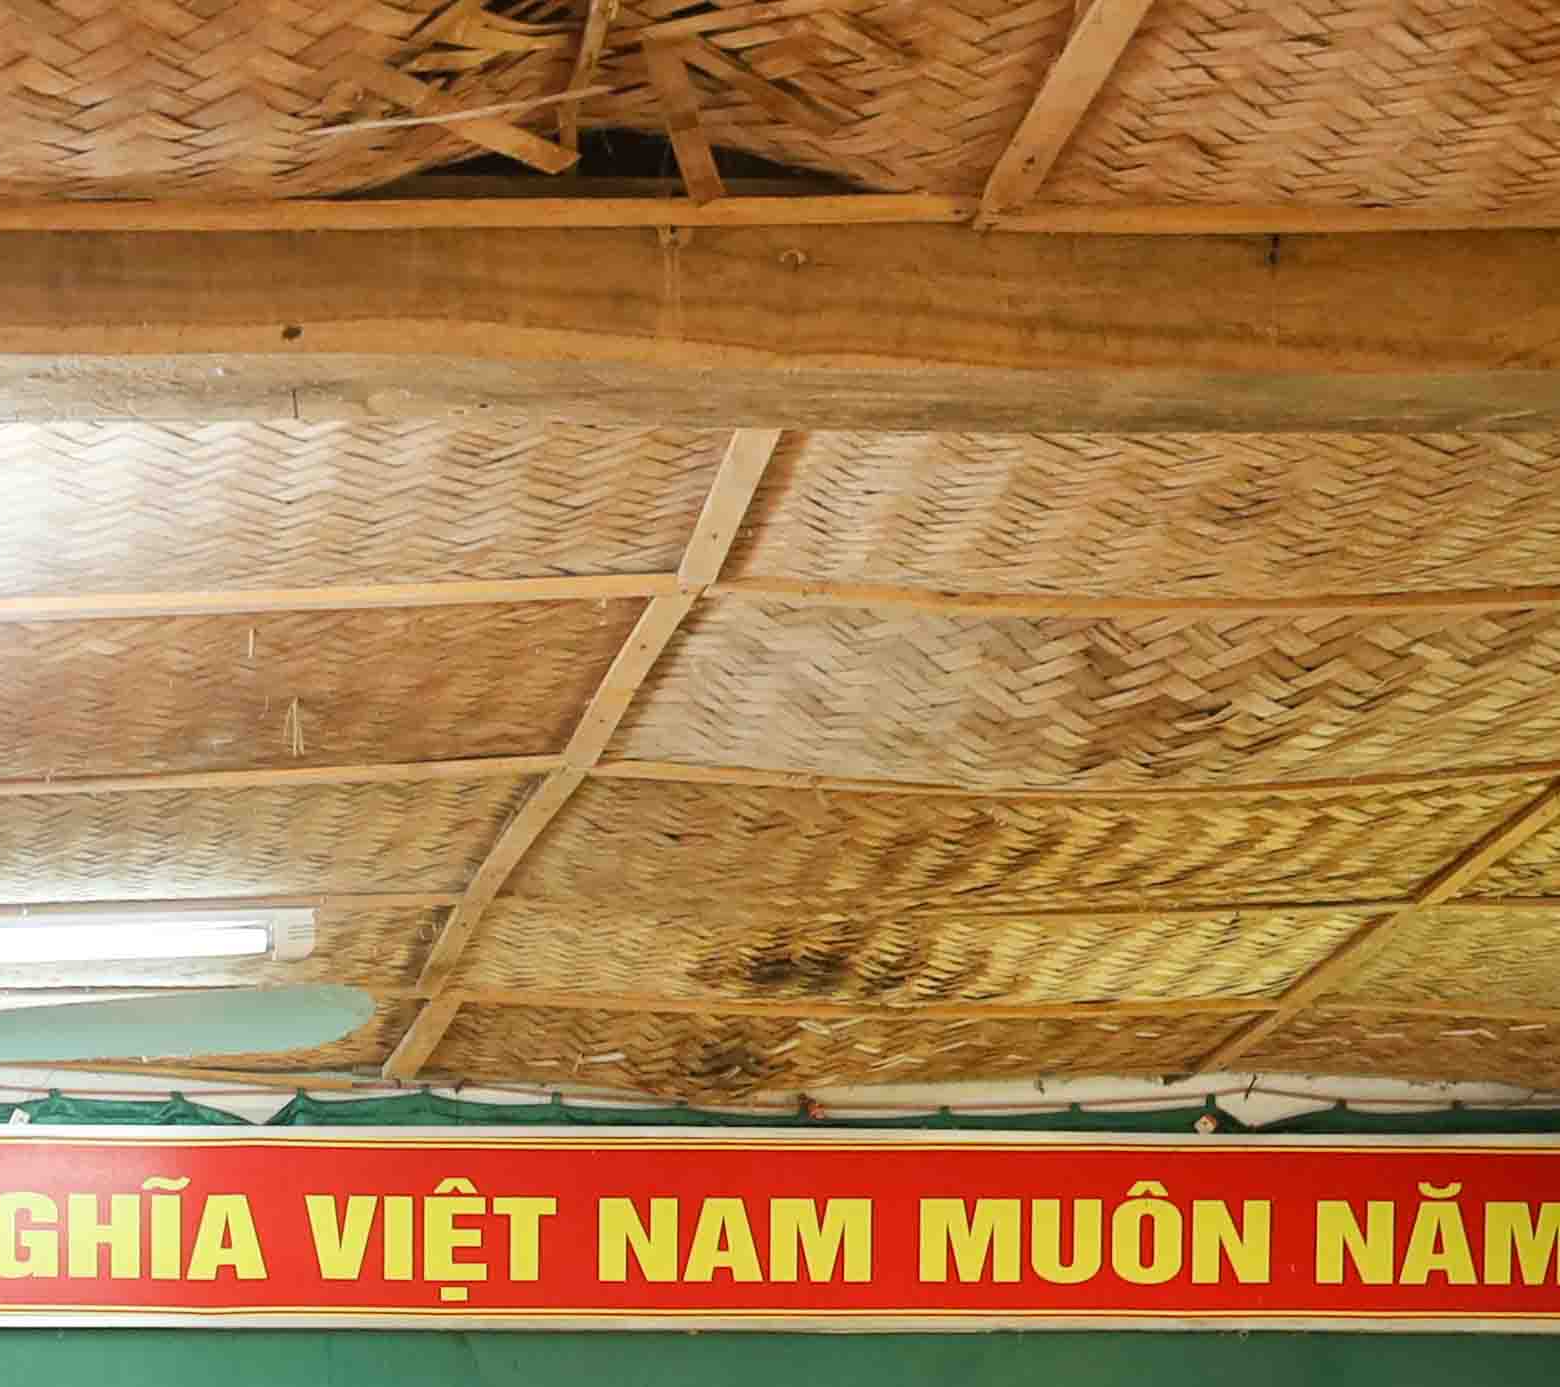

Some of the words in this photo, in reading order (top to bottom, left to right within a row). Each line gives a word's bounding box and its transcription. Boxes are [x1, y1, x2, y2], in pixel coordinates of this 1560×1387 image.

[305, 1177, 557, 1302] VIỆT
[597, 1195, 873, 1284] NAM
[919, 1180, 1271, 1285] MUÔN
